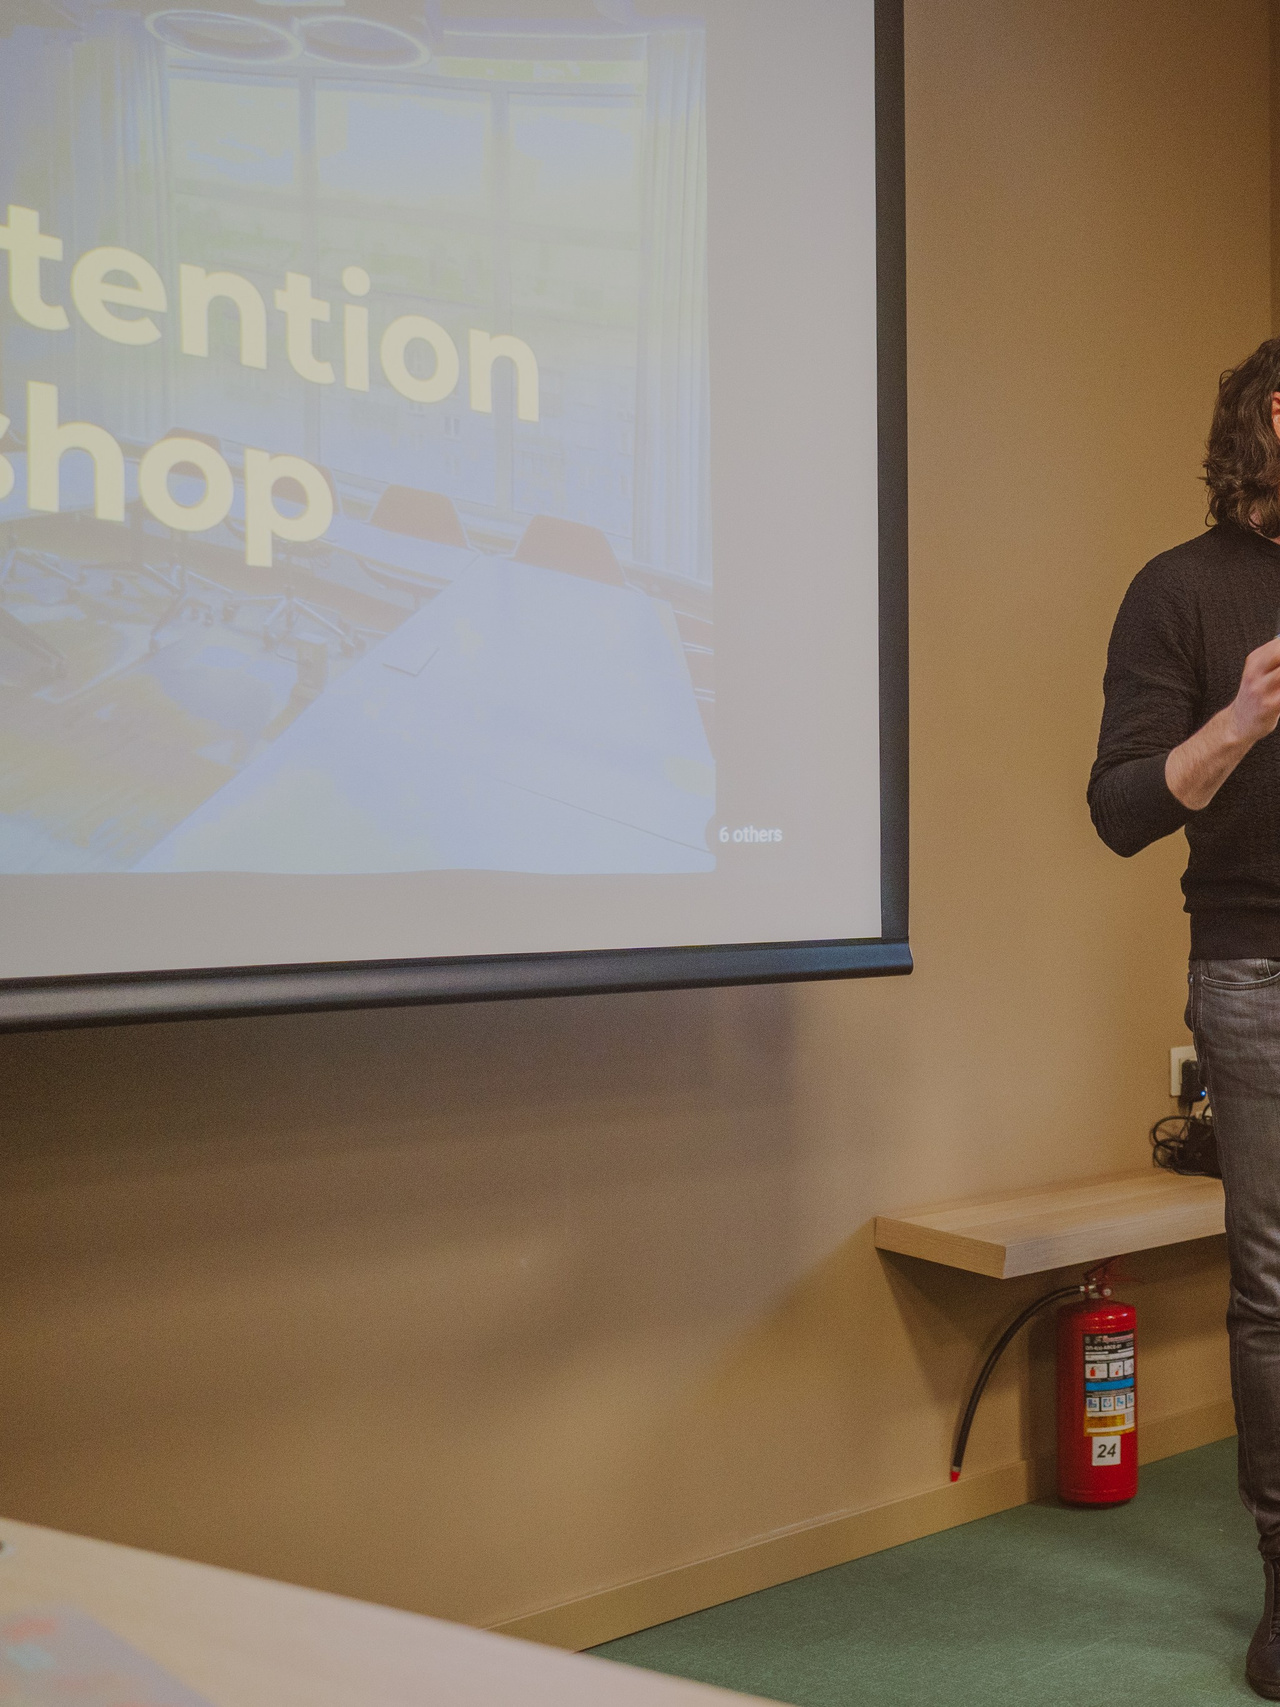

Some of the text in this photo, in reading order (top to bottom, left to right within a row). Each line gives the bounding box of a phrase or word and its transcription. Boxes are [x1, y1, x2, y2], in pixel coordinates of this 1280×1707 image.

[0, 204, 540, 423] tention
[719, 825, 783, 842] 6 others
[1097, 1443, 1117, 1458] 24
